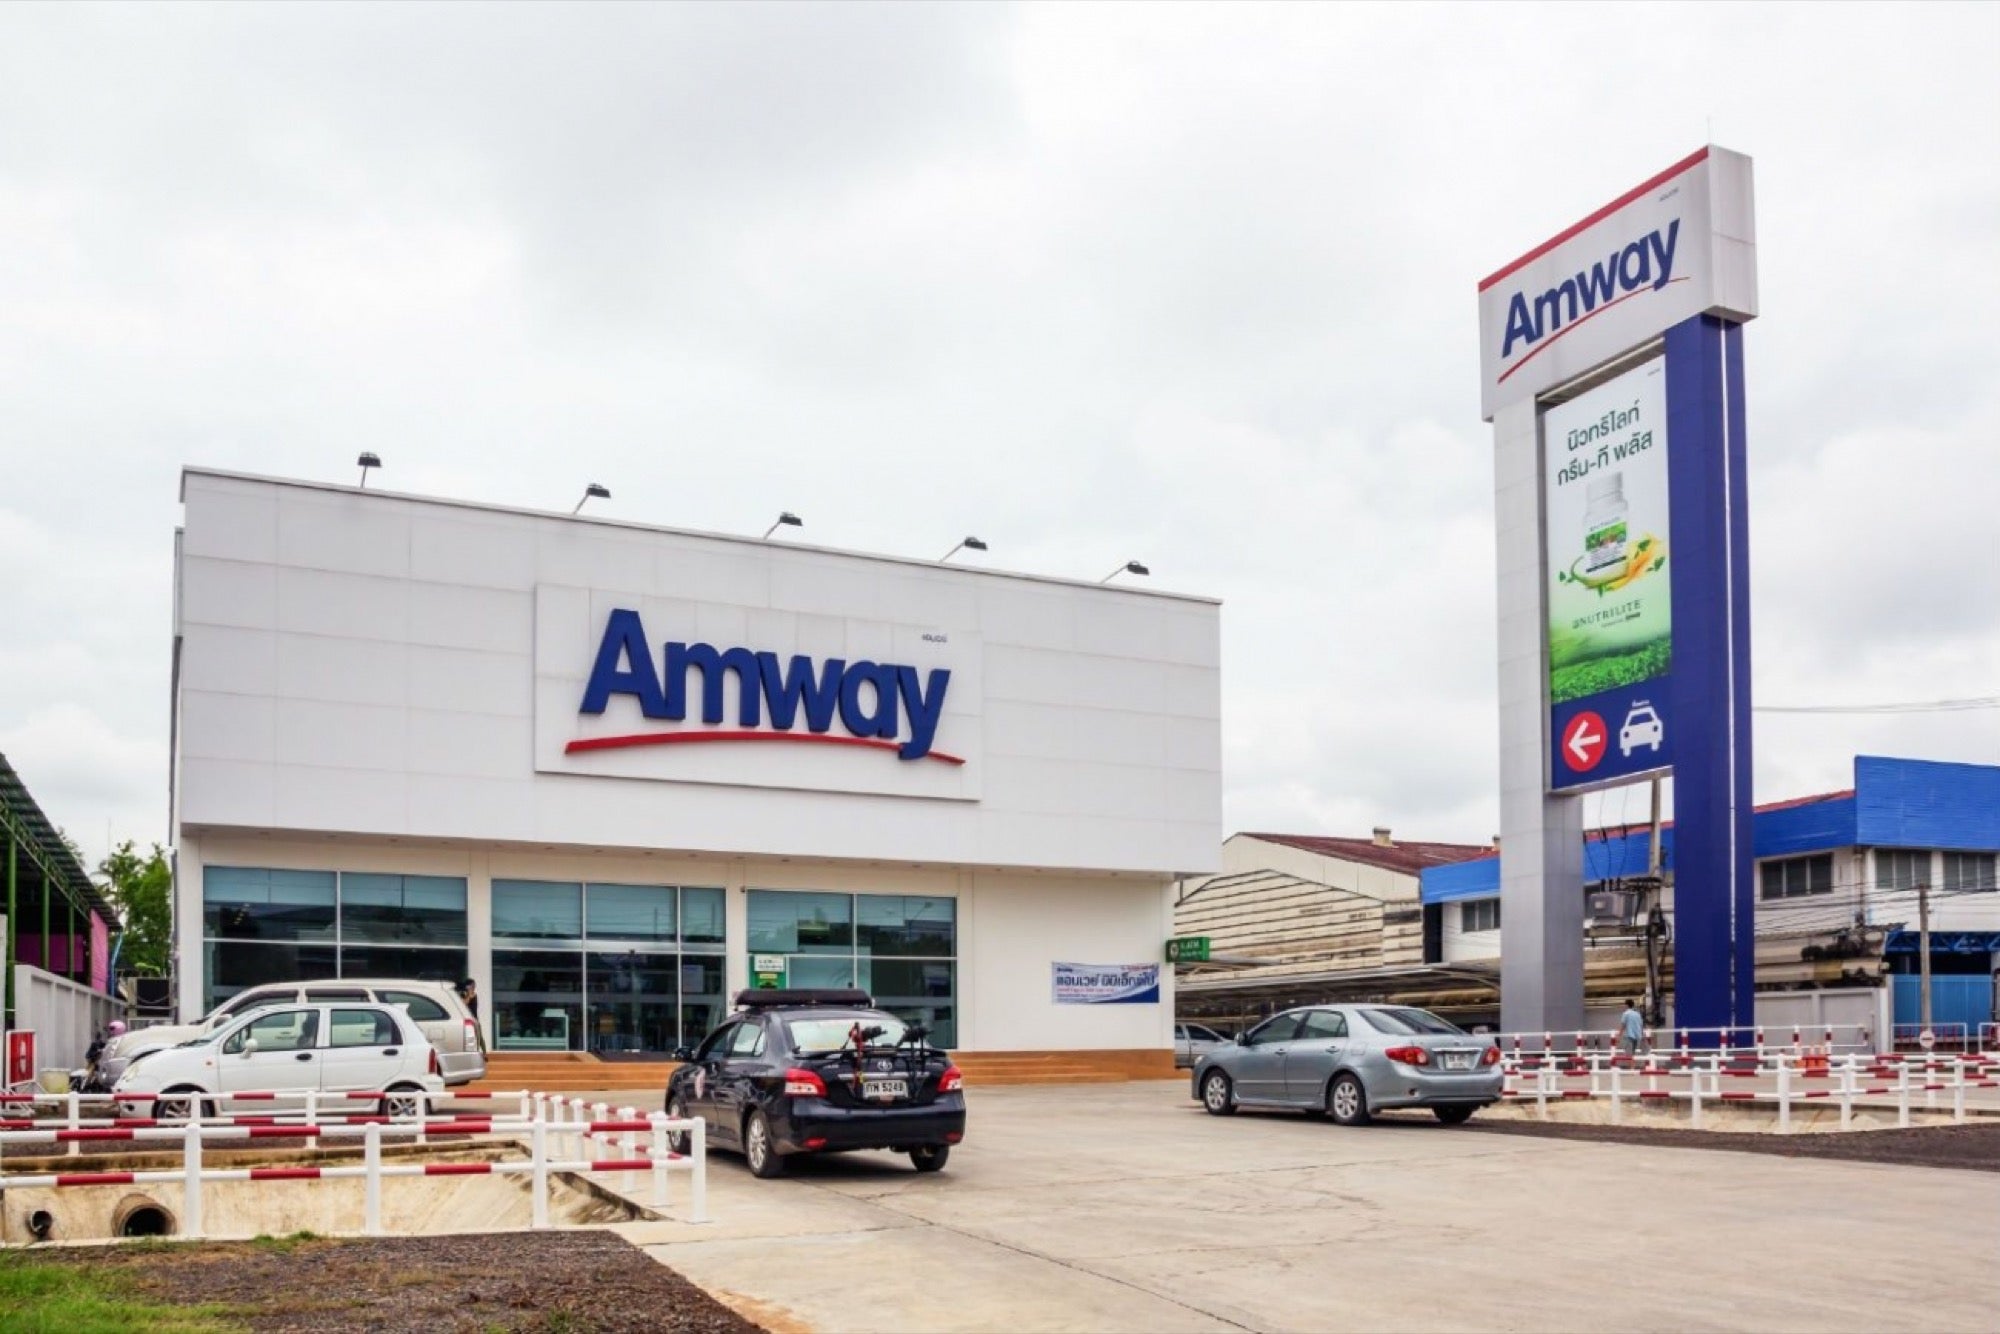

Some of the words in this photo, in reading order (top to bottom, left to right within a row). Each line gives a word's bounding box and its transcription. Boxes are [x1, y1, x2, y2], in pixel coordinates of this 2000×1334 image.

[1502, 218, 1680, 359] Amway
[1567, 398, 1640, 452] นิวทริไลท์
[1580, 599, 1641, 624] NUTRILITE
[580, 608, 951, 760] Amway
